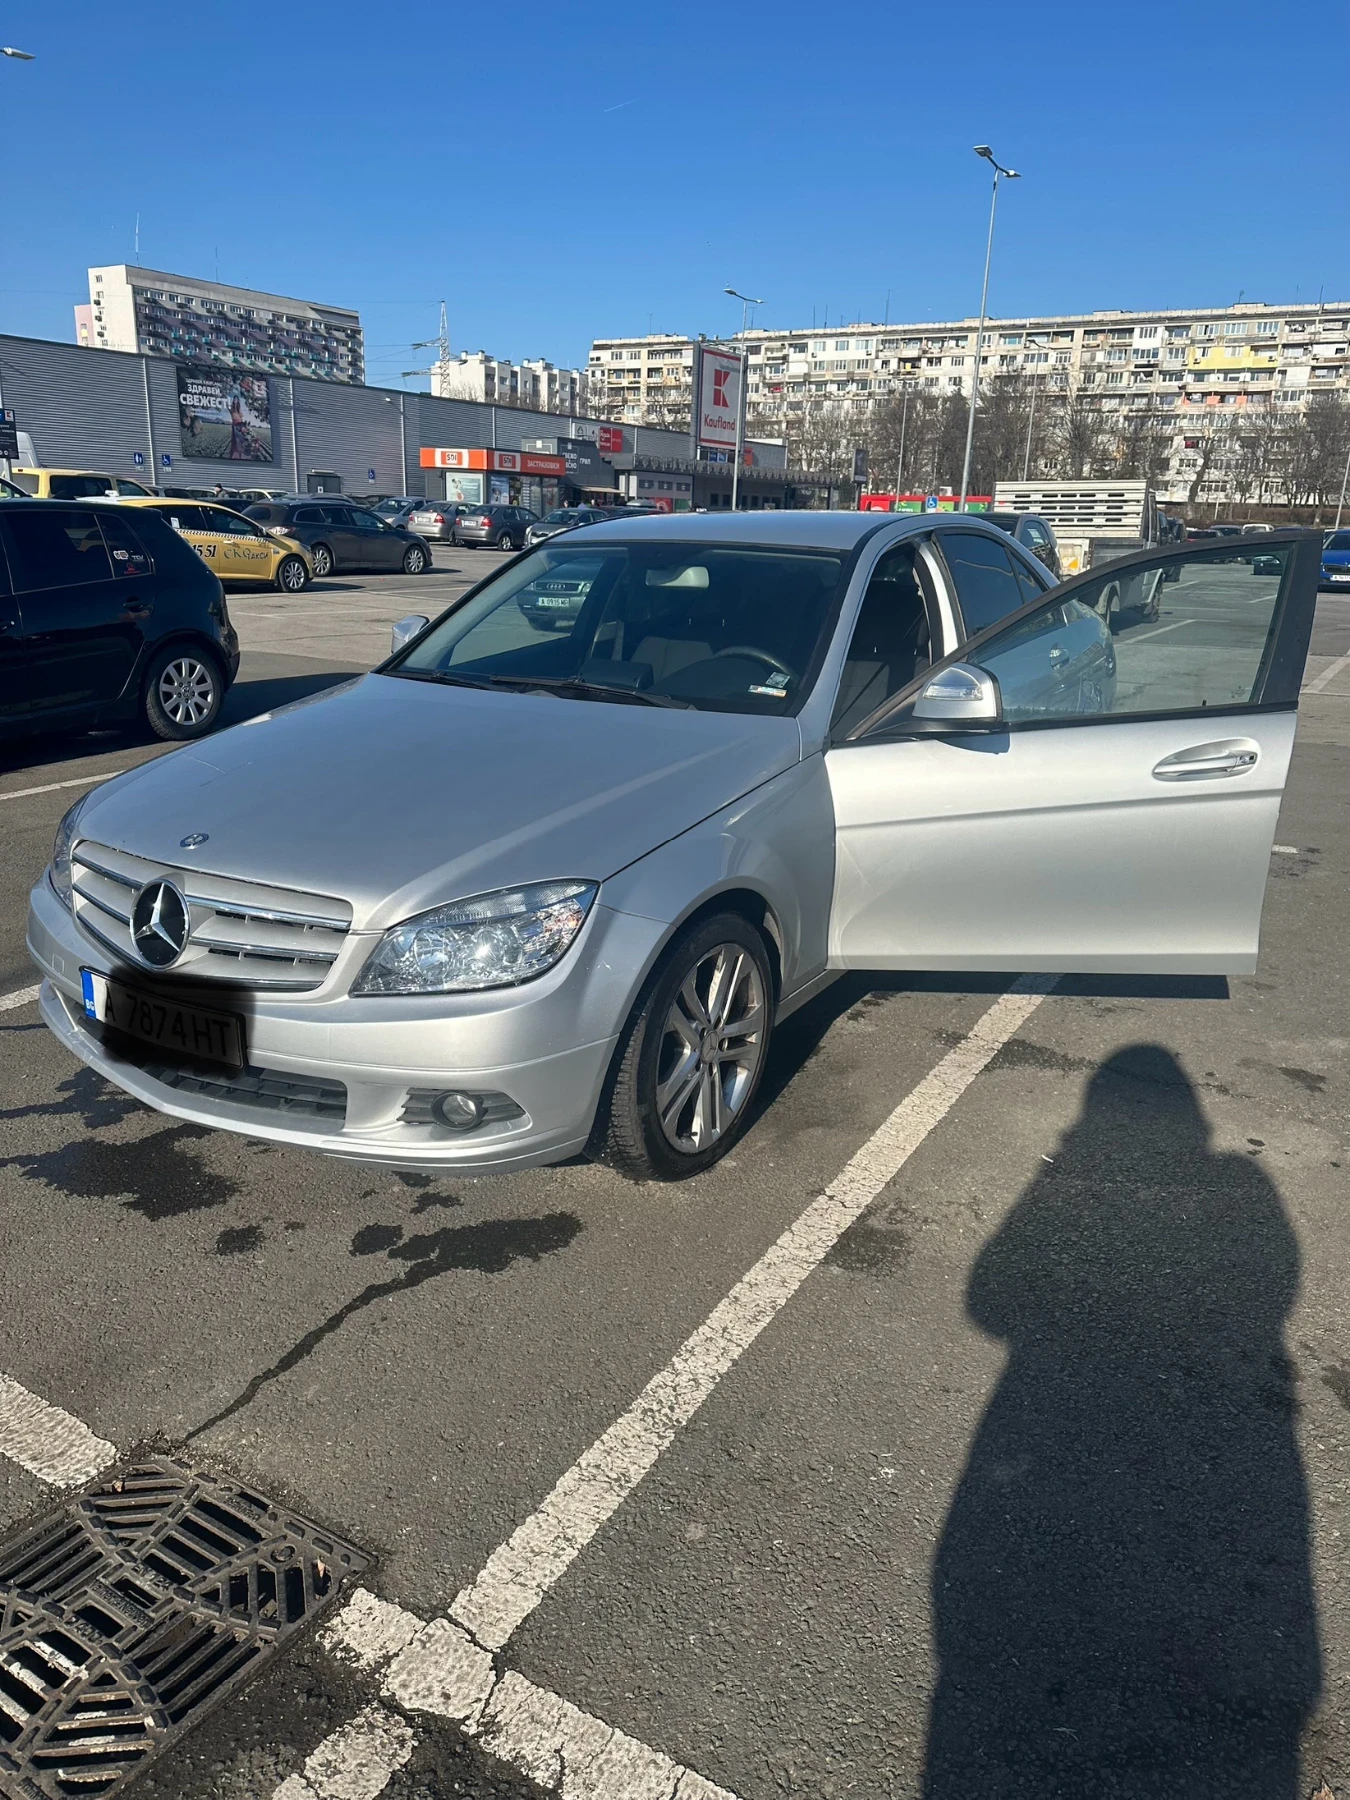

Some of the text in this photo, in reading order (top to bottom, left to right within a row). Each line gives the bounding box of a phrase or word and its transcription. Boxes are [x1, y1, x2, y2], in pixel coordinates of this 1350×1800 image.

[704, 413, 735, 431] Kaufland
[527, 460, 560, 469] ЗАСТРАХОВКИ
[579, 457, 591, 465] ГРИЛ
[204, 544, 217, 558] 51
[85, 999, 95, 1012] BG
[104, 981, 117, 1022] A
